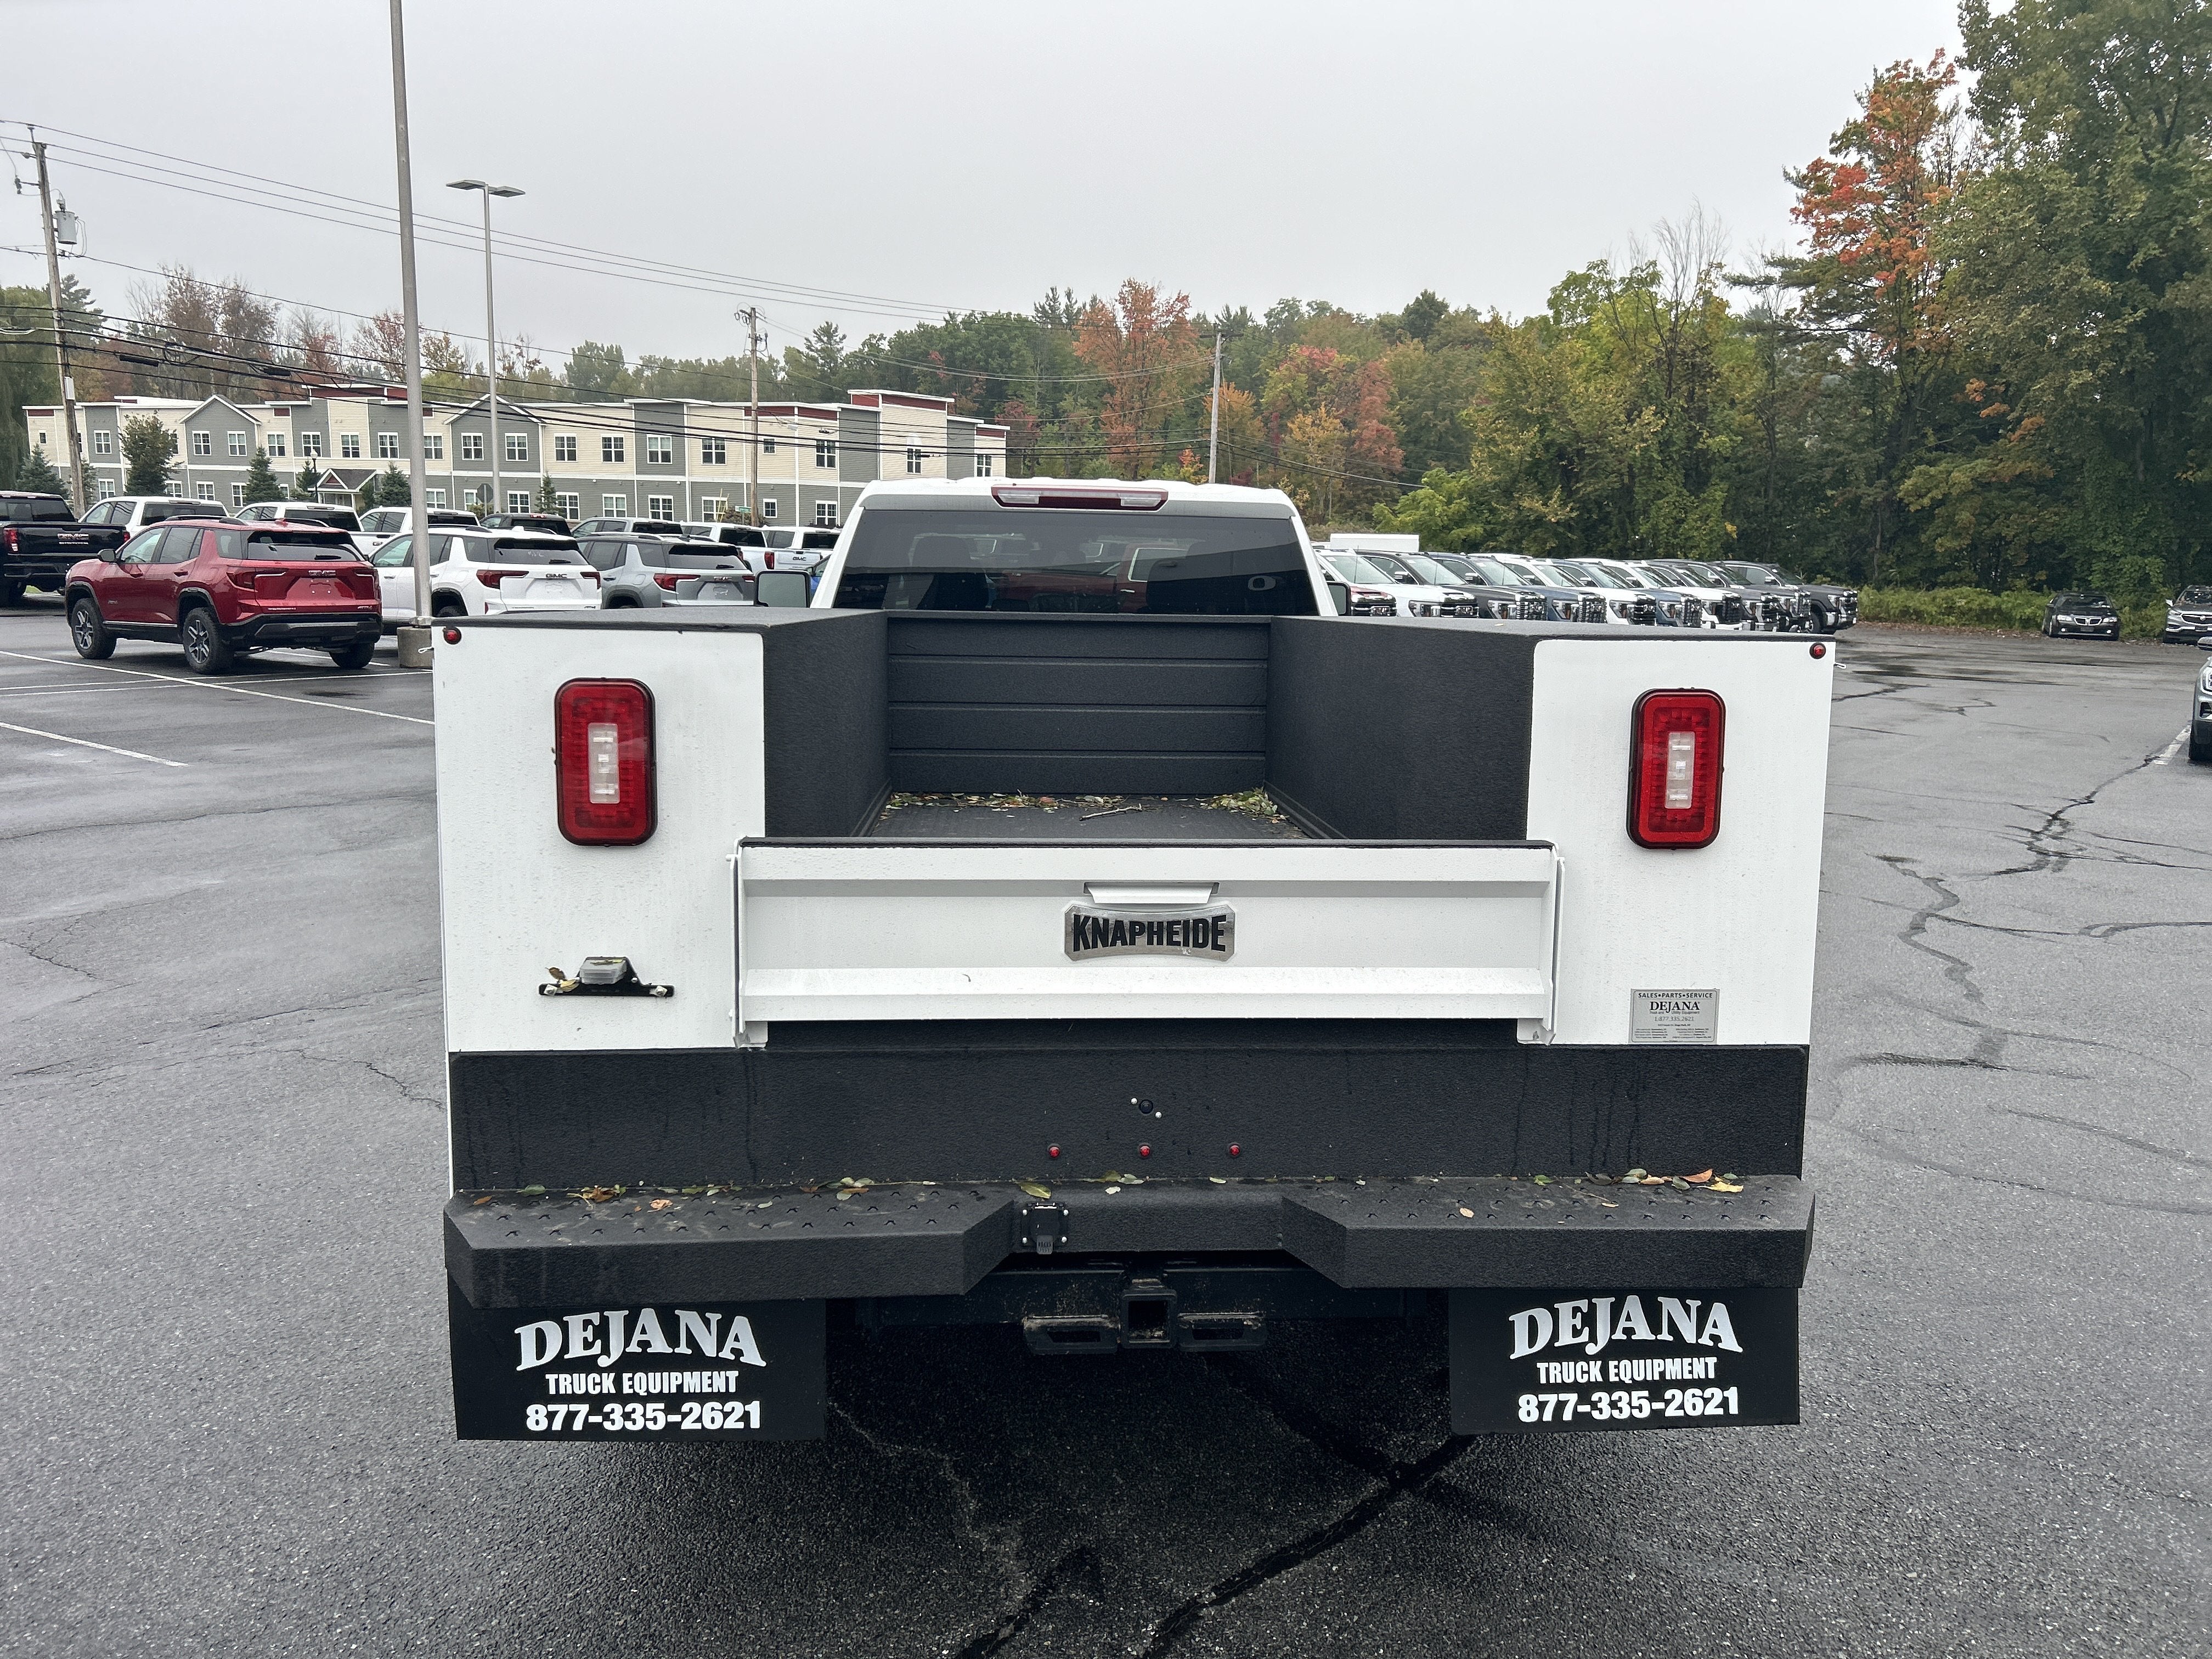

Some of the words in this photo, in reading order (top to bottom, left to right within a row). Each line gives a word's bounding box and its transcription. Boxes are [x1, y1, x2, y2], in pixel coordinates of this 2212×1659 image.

[1073, 915, 1227, 952] KNAPHEIDE
[1649, 1001, 1700, 1013] DEJANA
[514, 1307, 766, 1372] DEJANA
[1509, 1295, 1743, 1359] DEJANA
[545, 1373, 616, 1395] TRUCK
[623, 1370, 739, 1395] EQUIPMENT
[1537, 1361, 1604, 1384] TRUCK
[1609, 1357, 1717, 1383] EQUIPMENT
[526, 1401, 760, 1431] 877-335-2621
[1517, 1386, 1739, 1423] 877-335-2621
